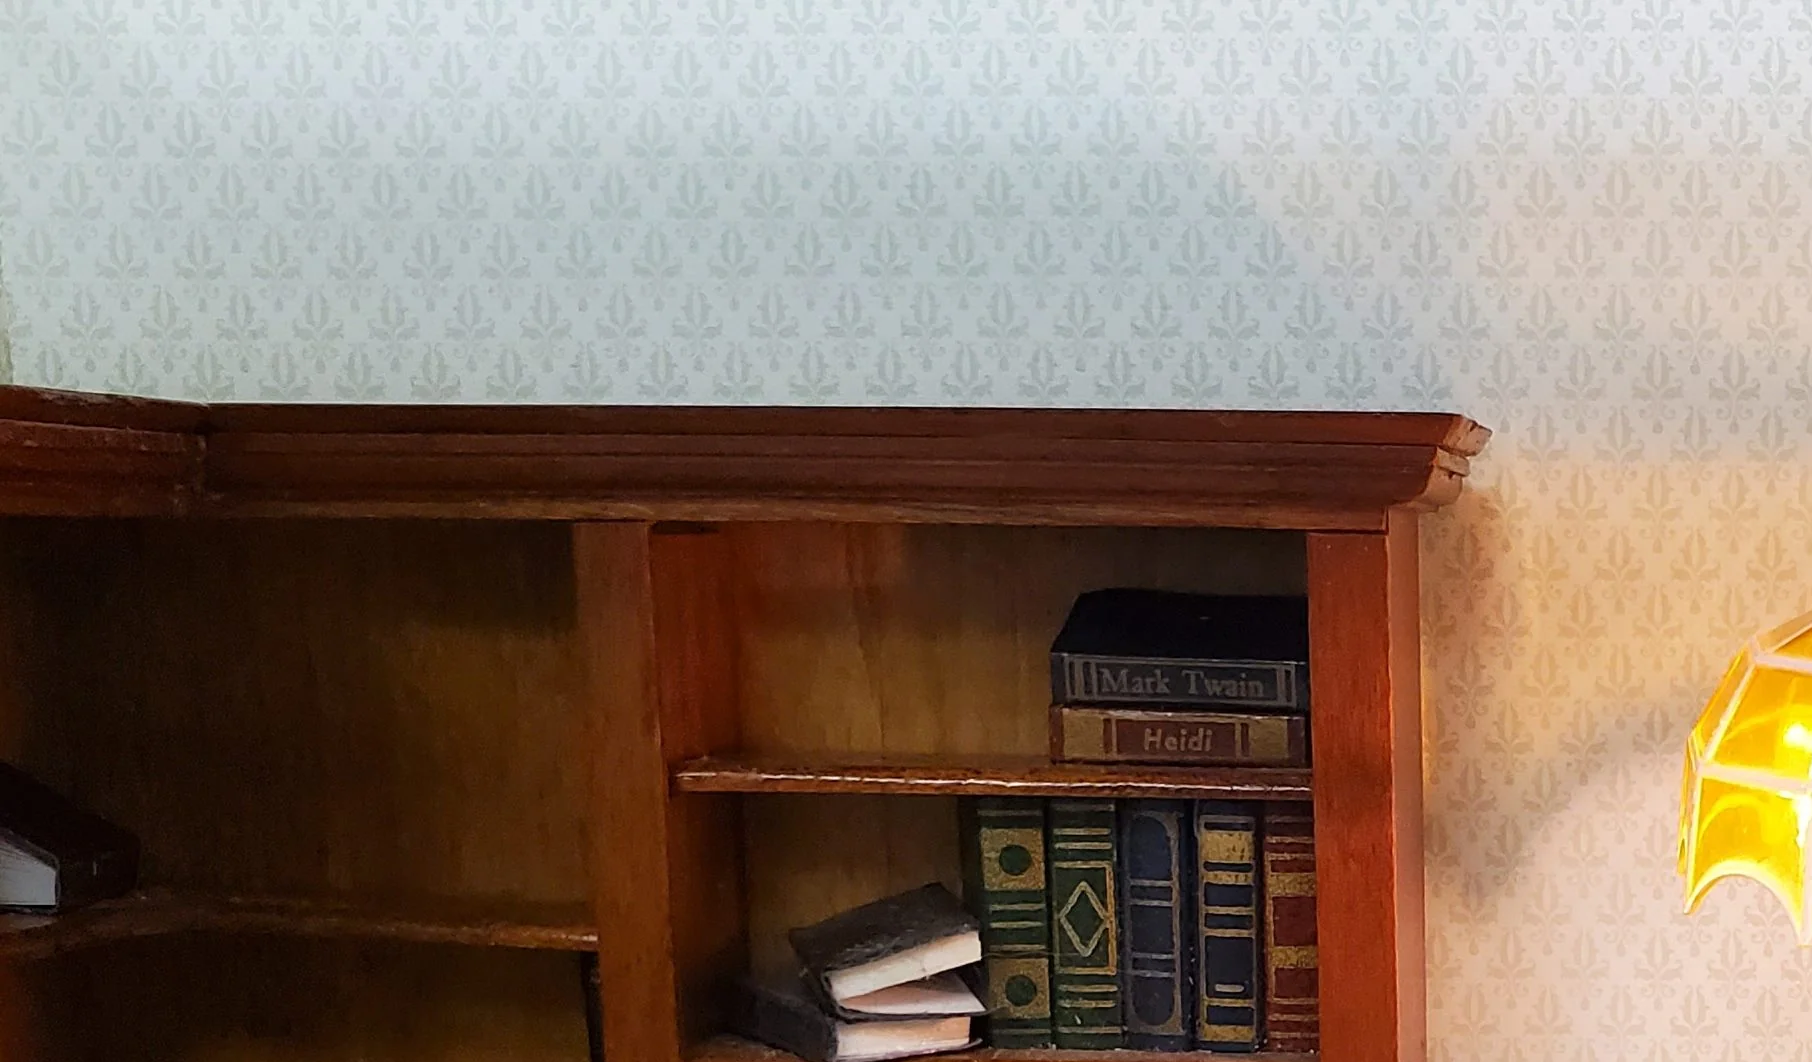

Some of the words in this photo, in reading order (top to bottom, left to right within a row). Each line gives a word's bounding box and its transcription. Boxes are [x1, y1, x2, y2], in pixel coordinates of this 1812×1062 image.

[1099, 667, 1170, 694] Mark
[1182, 669, 1264, 698] Twain
[1143, 727, 1213, 752] Heidi
